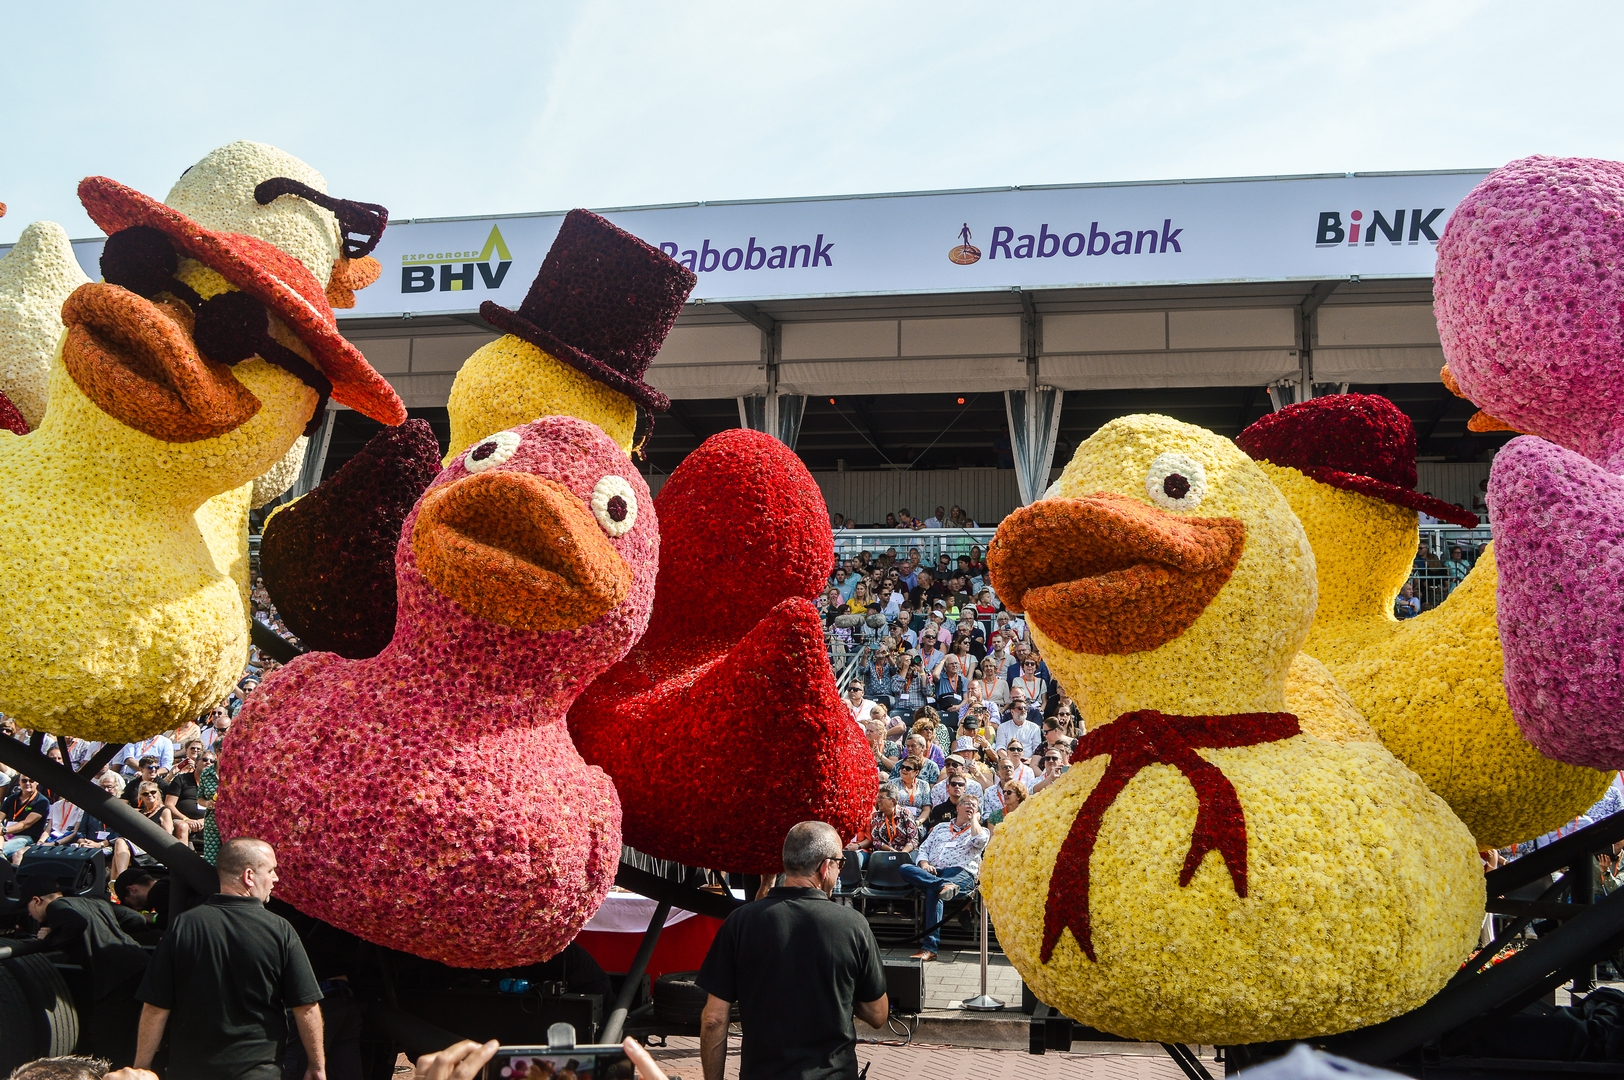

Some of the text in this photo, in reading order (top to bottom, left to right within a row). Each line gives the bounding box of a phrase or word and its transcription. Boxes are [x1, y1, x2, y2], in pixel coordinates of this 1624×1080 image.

[401, 251, 479, 261] EXPOGROEP
[988, 219, 1184, 260] Rabobank
[401, 261, 513, 294] BHV
